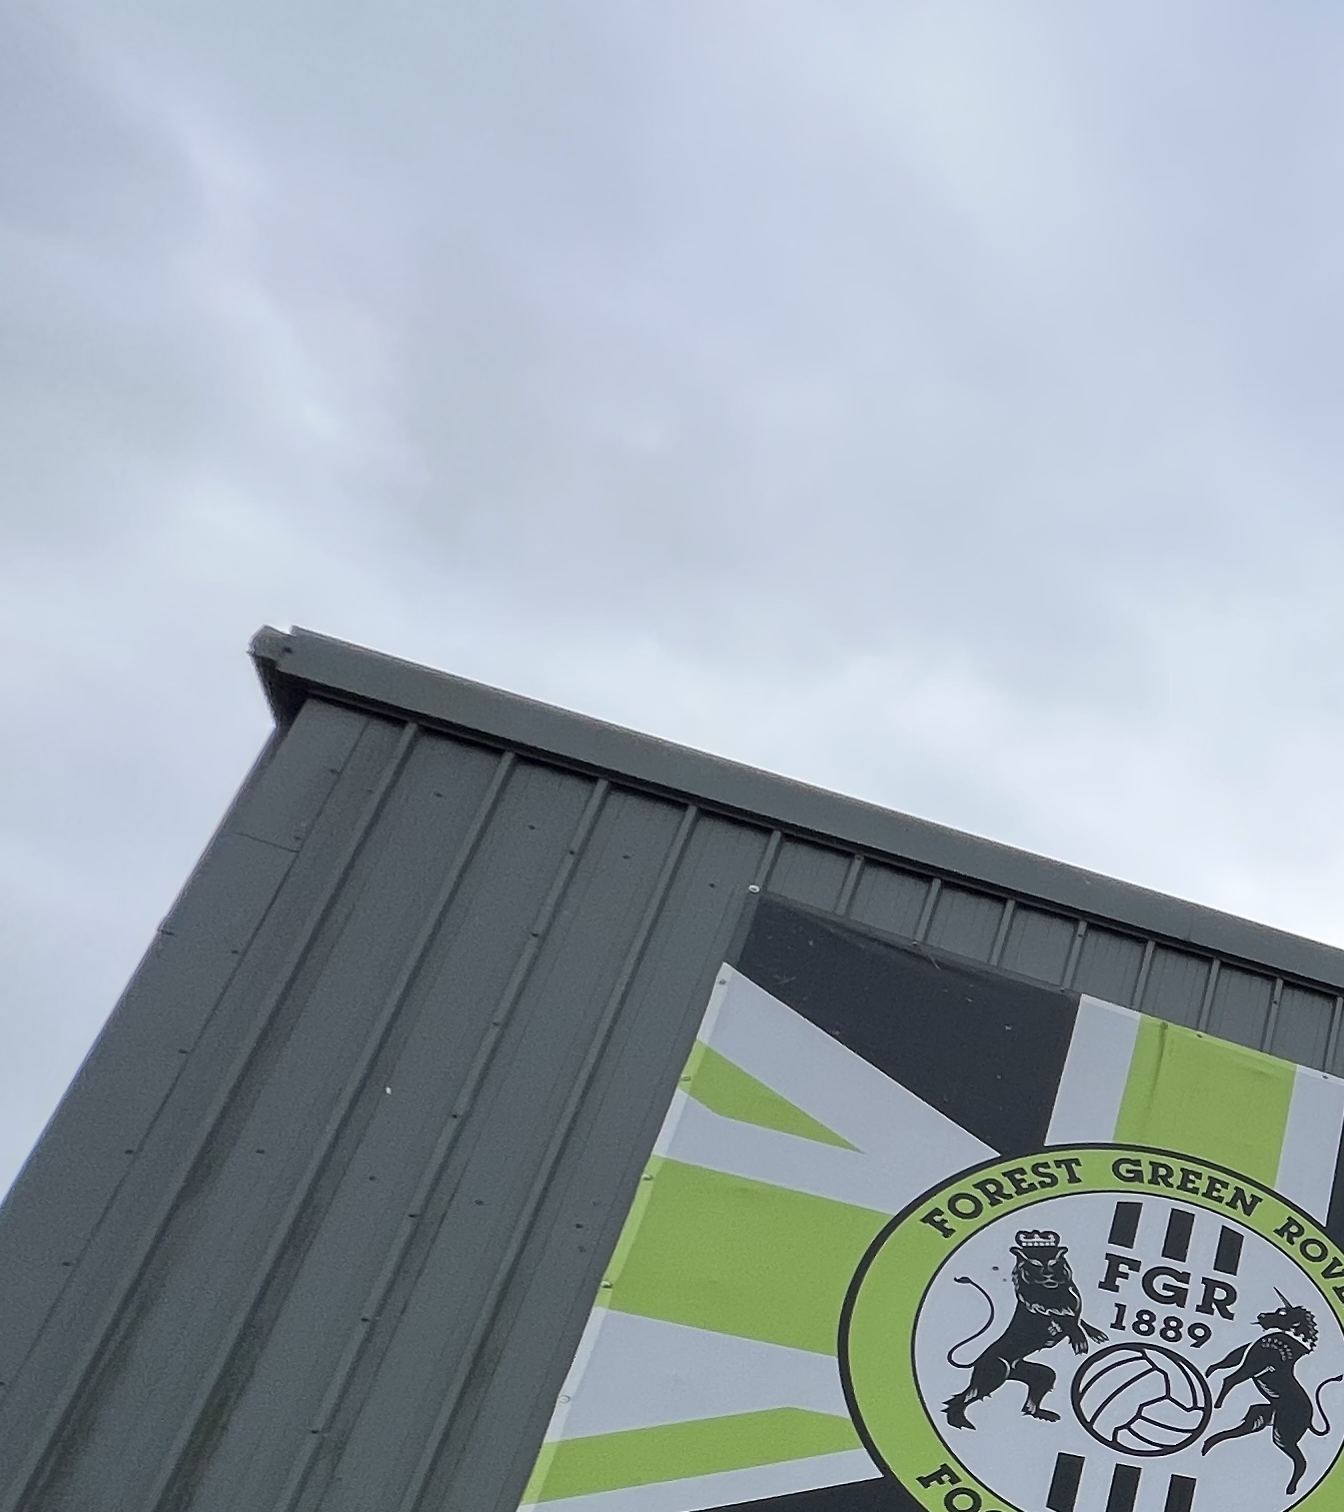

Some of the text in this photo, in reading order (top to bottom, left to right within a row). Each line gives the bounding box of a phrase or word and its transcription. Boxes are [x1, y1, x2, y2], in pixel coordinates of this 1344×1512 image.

[920, 1158, 1083, 1239] FOREST
[1111, 1158, 1263, 1218] GREEN
[1098, 1253, 1238, 1321] FGR
[1110, 1302, 1213, 1349] 1889
